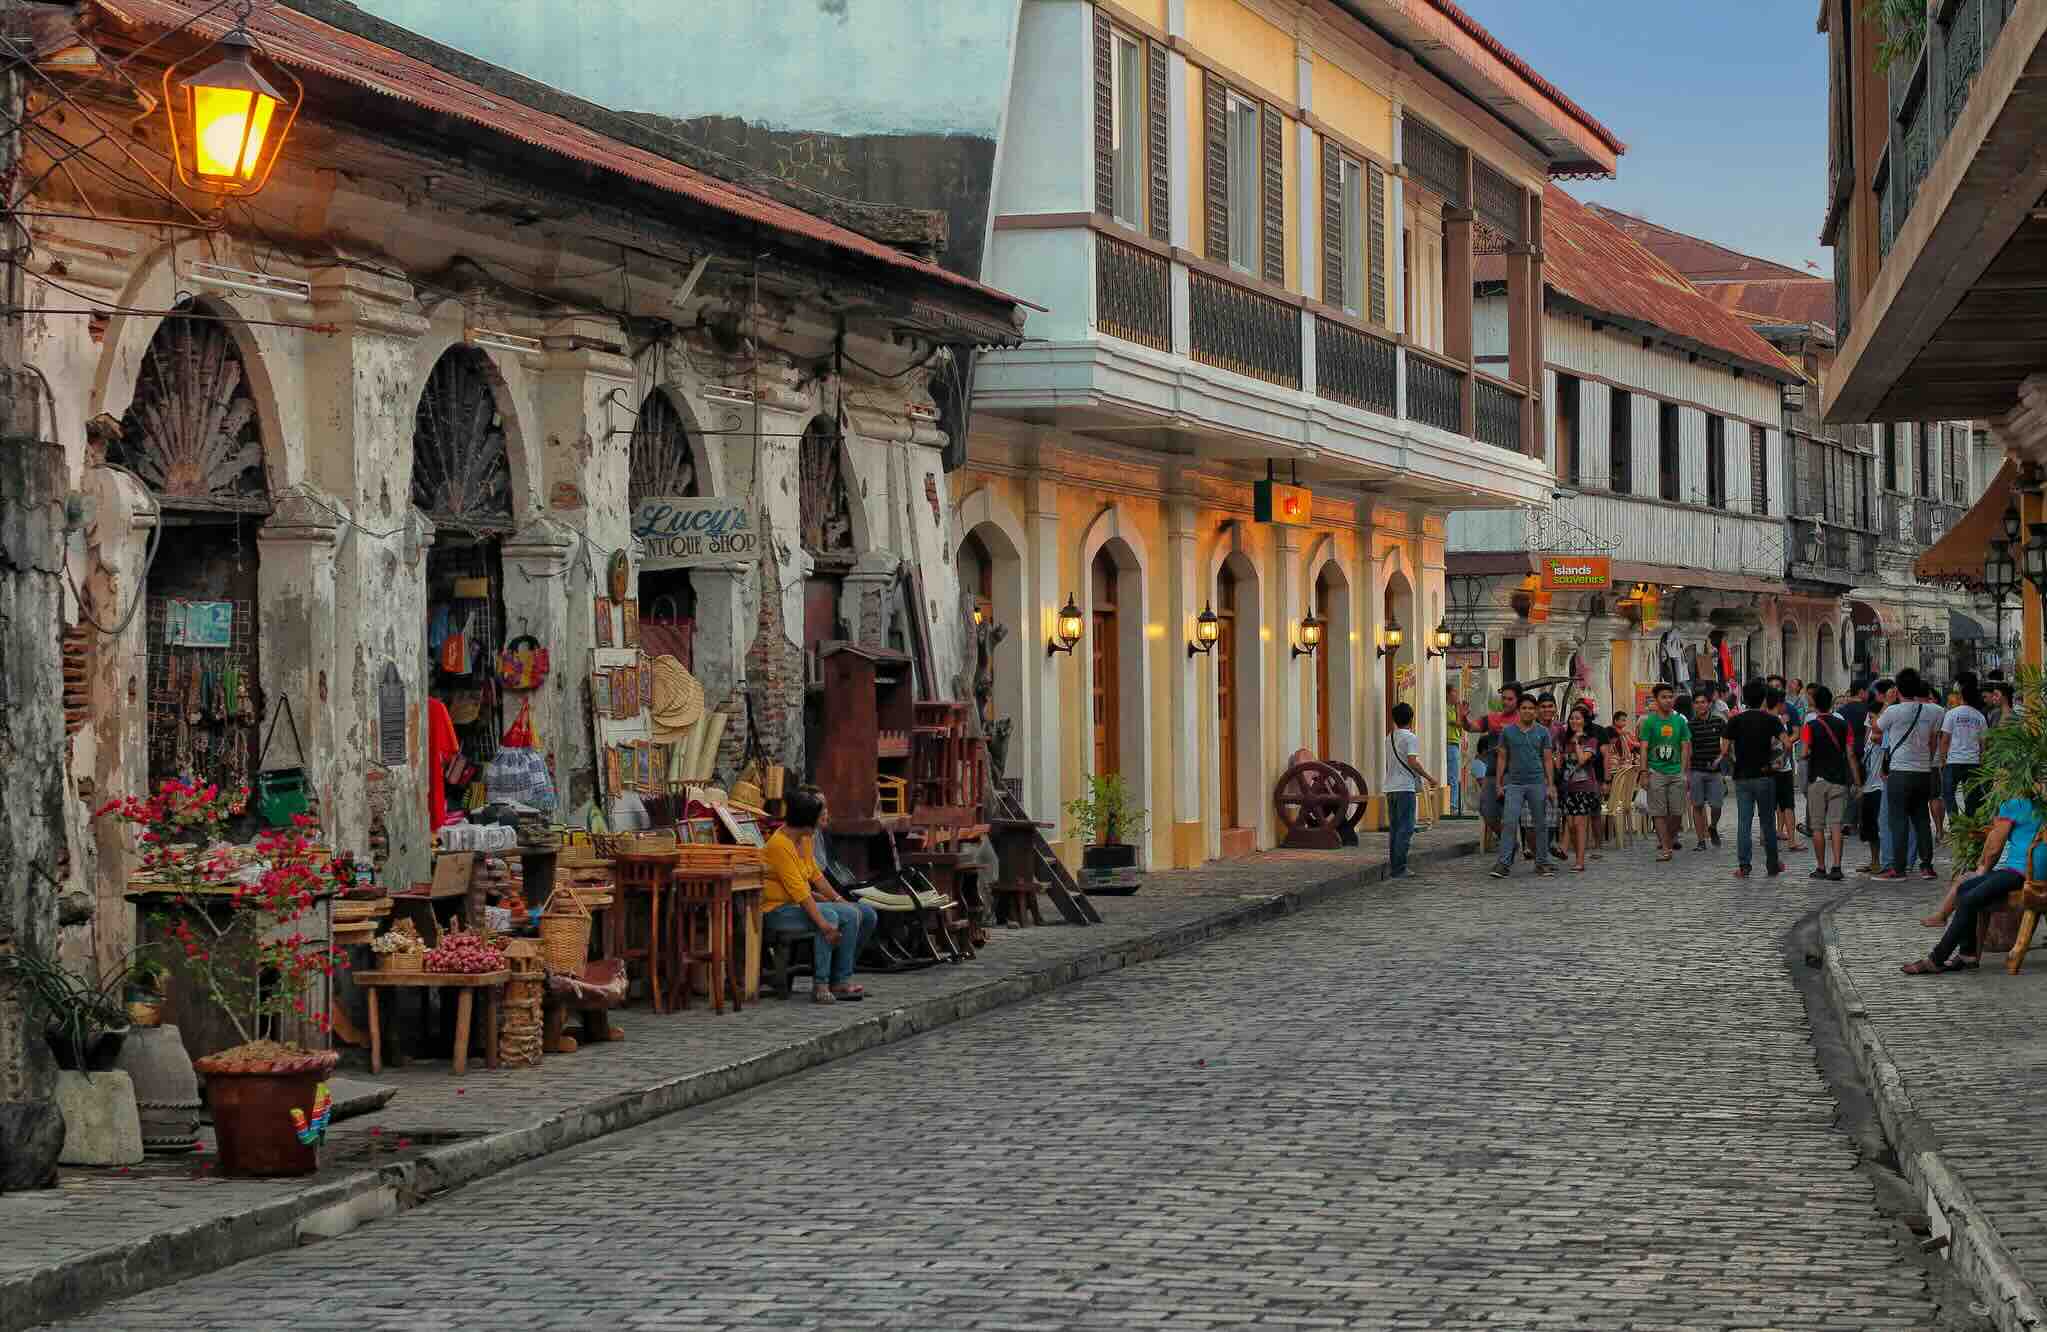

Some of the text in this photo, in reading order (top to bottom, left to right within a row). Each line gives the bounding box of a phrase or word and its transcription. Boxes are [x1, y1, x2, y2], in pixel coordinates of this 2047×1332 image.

[637, 504, 748, 539] Lucy's
[709, 533, 757, 553] SHOP
[1554, 564, 1592, 576] islands
[1552, 575, 1605, 585] souvenirs
